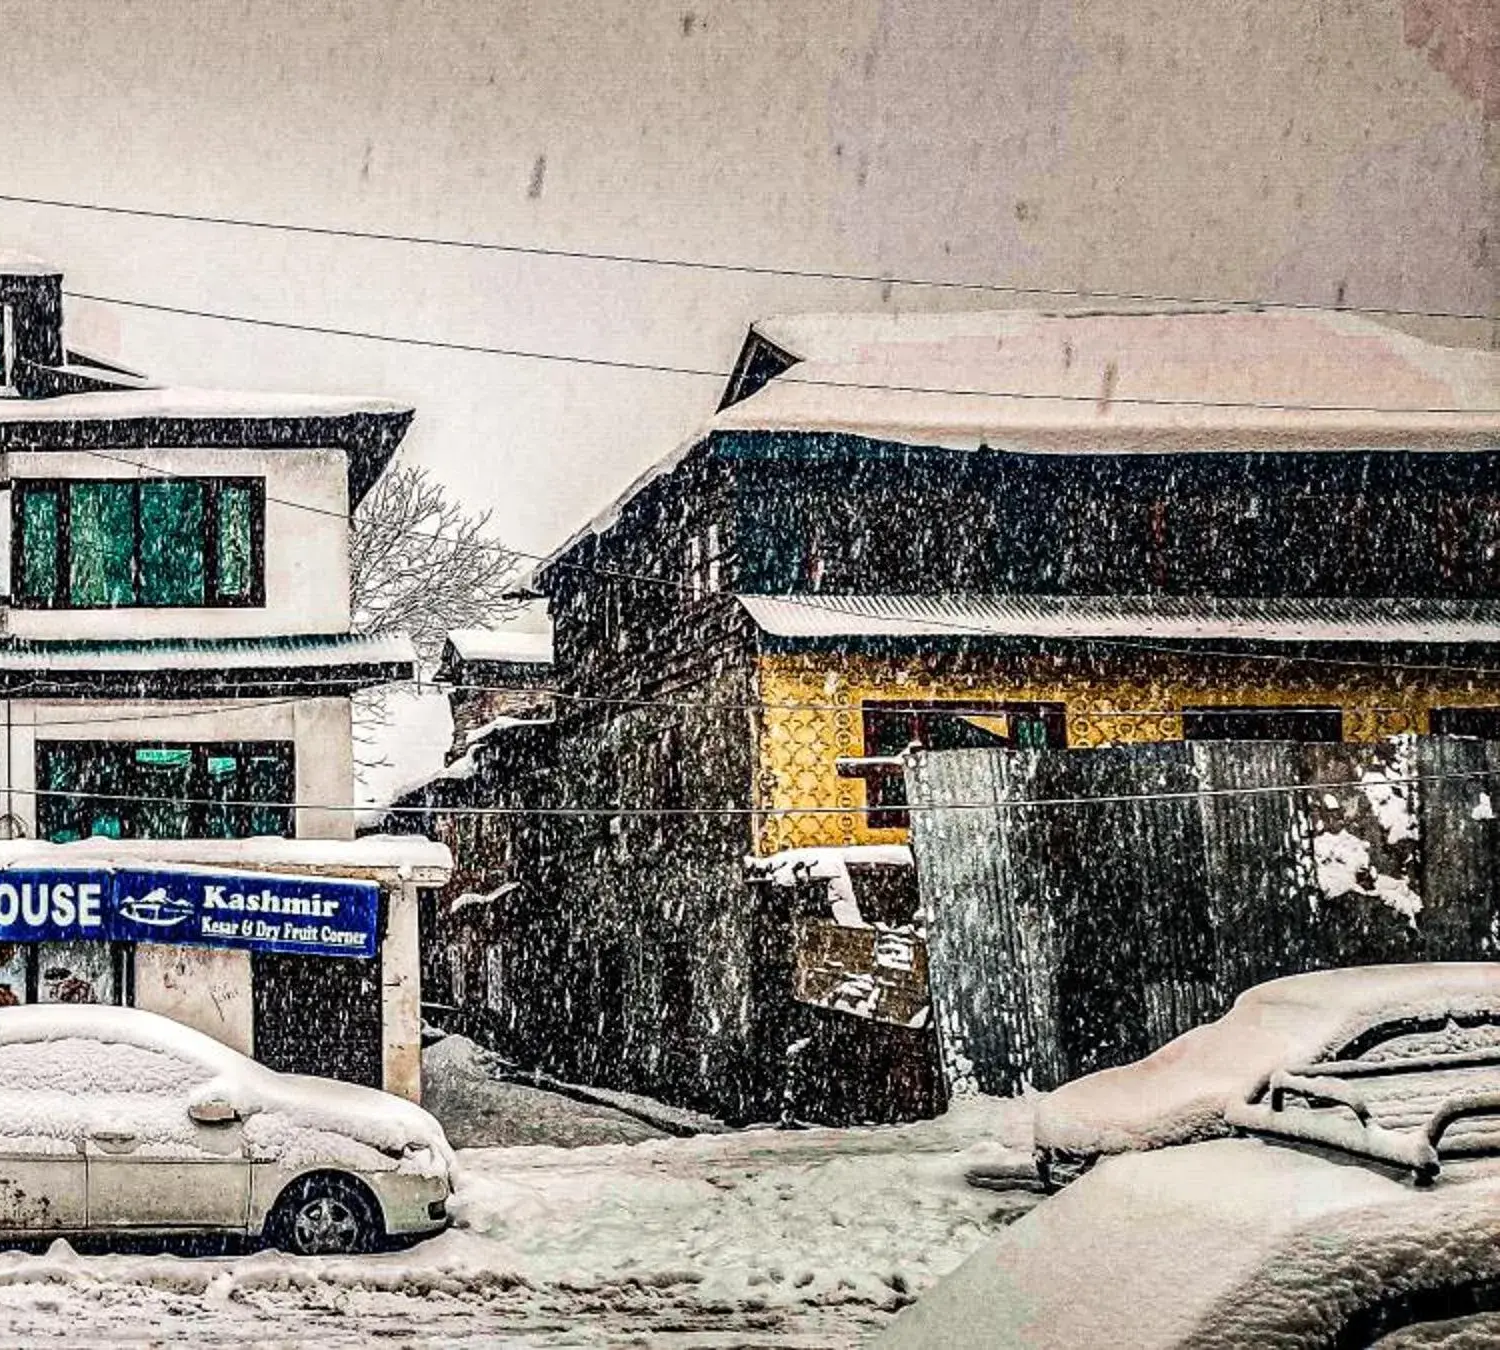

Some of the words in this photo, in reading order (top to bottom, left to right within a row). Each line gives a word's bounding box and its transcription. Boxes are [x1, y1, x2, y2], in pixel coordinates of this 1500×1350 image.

[203, 885, 340, 917] Kashmir
[202, 916, 240, 936] Kesar
[241, 919, 254, 937] &
[256, 920, 281, 941] Dry
[284, 922, 319, 942] Fruit
[321, 925, 368, 946] Corner
